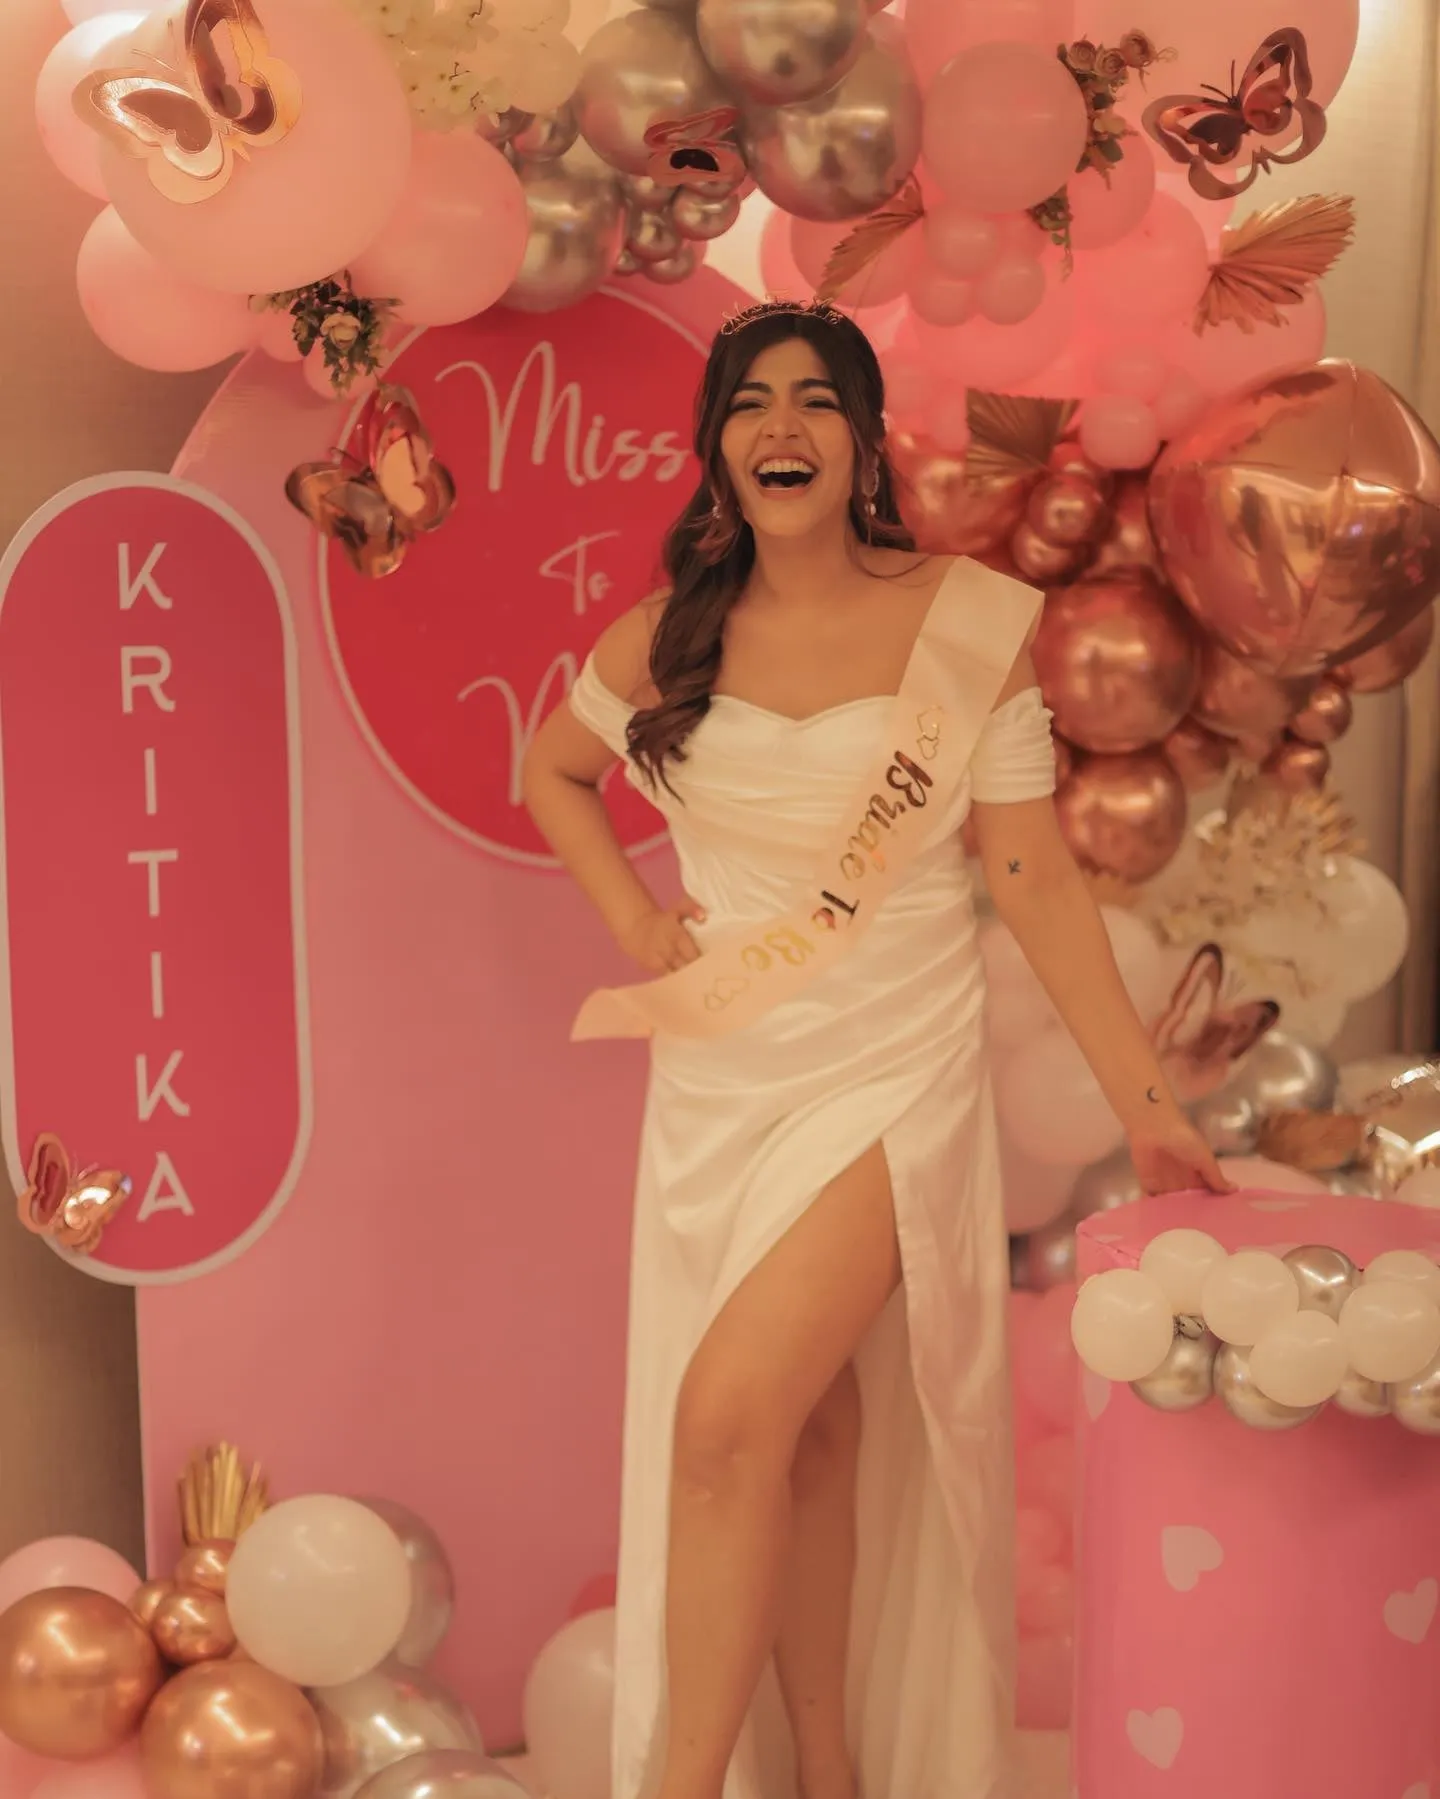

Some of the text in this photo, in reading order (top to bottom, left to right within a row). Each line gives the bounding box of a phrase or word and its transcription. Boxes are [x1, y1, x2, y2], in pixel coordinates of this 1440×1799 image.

[434, 340, 691, 492] Miss
[538, 530, 621, 615] To
[117, 542, 195, 1222] KRITIKA
[741, 750, 934, 971] Bride To Be
